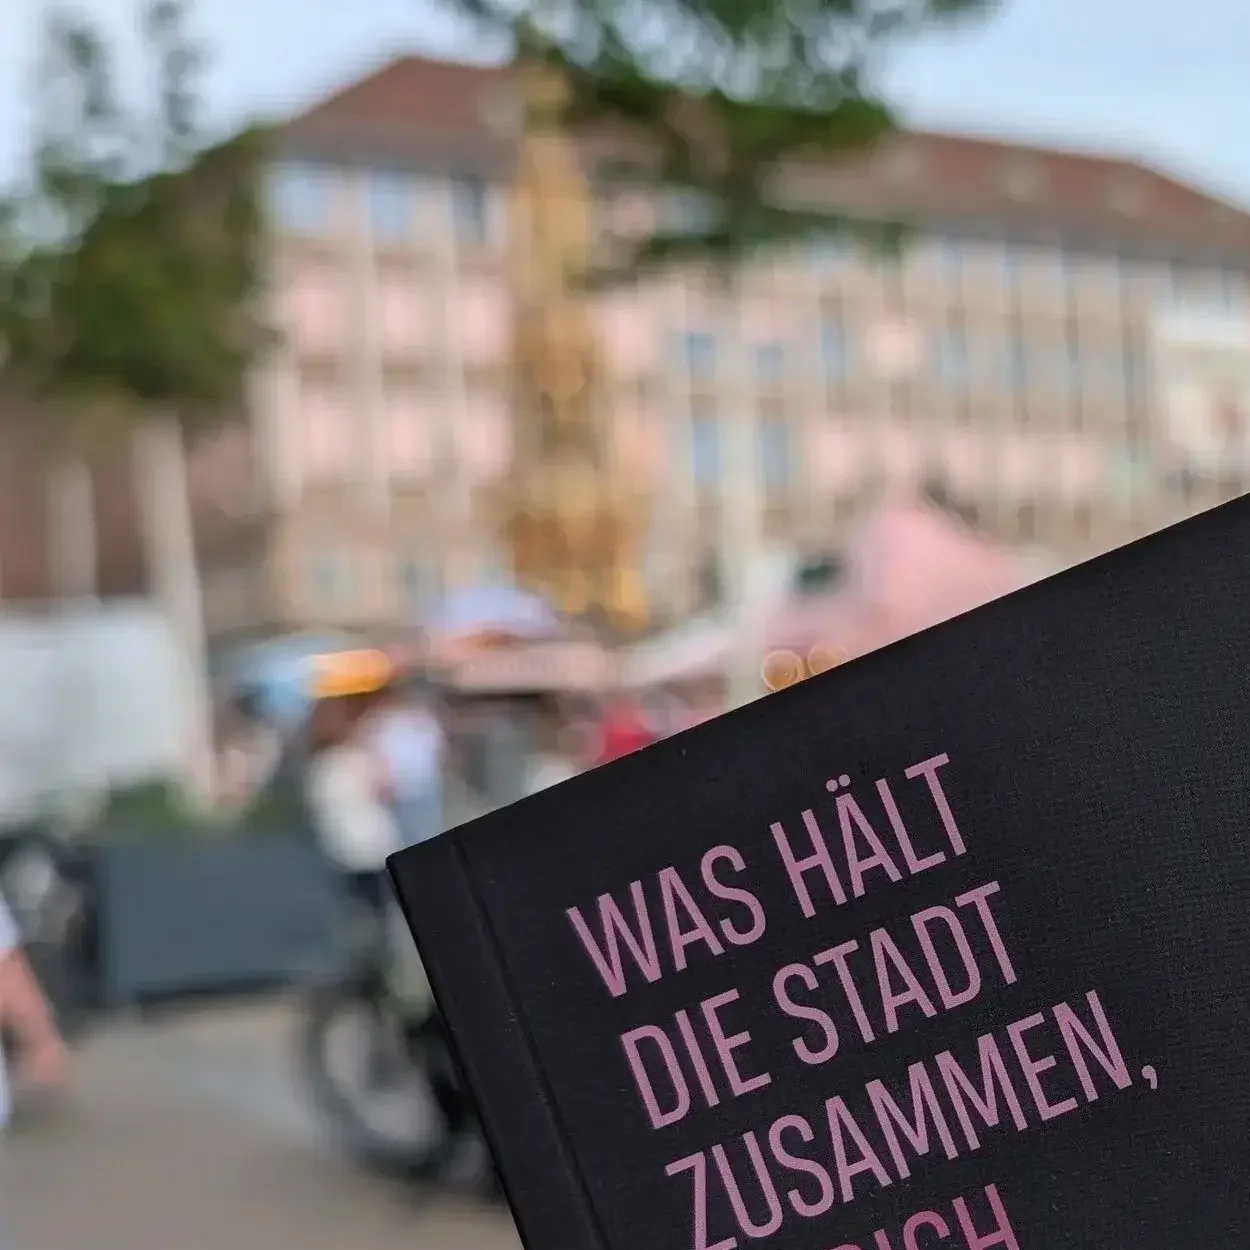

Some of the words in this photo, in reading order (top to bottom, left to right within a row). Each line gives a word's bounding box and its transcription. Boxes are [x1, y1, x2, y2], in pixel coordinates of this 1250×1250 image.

[565, 843, 767, 998] WAS
[769, 752, 968, 919] HÄLT
[620, 988, 772, 1130] DIE
[772, 880, 1018, 1066] STADT
